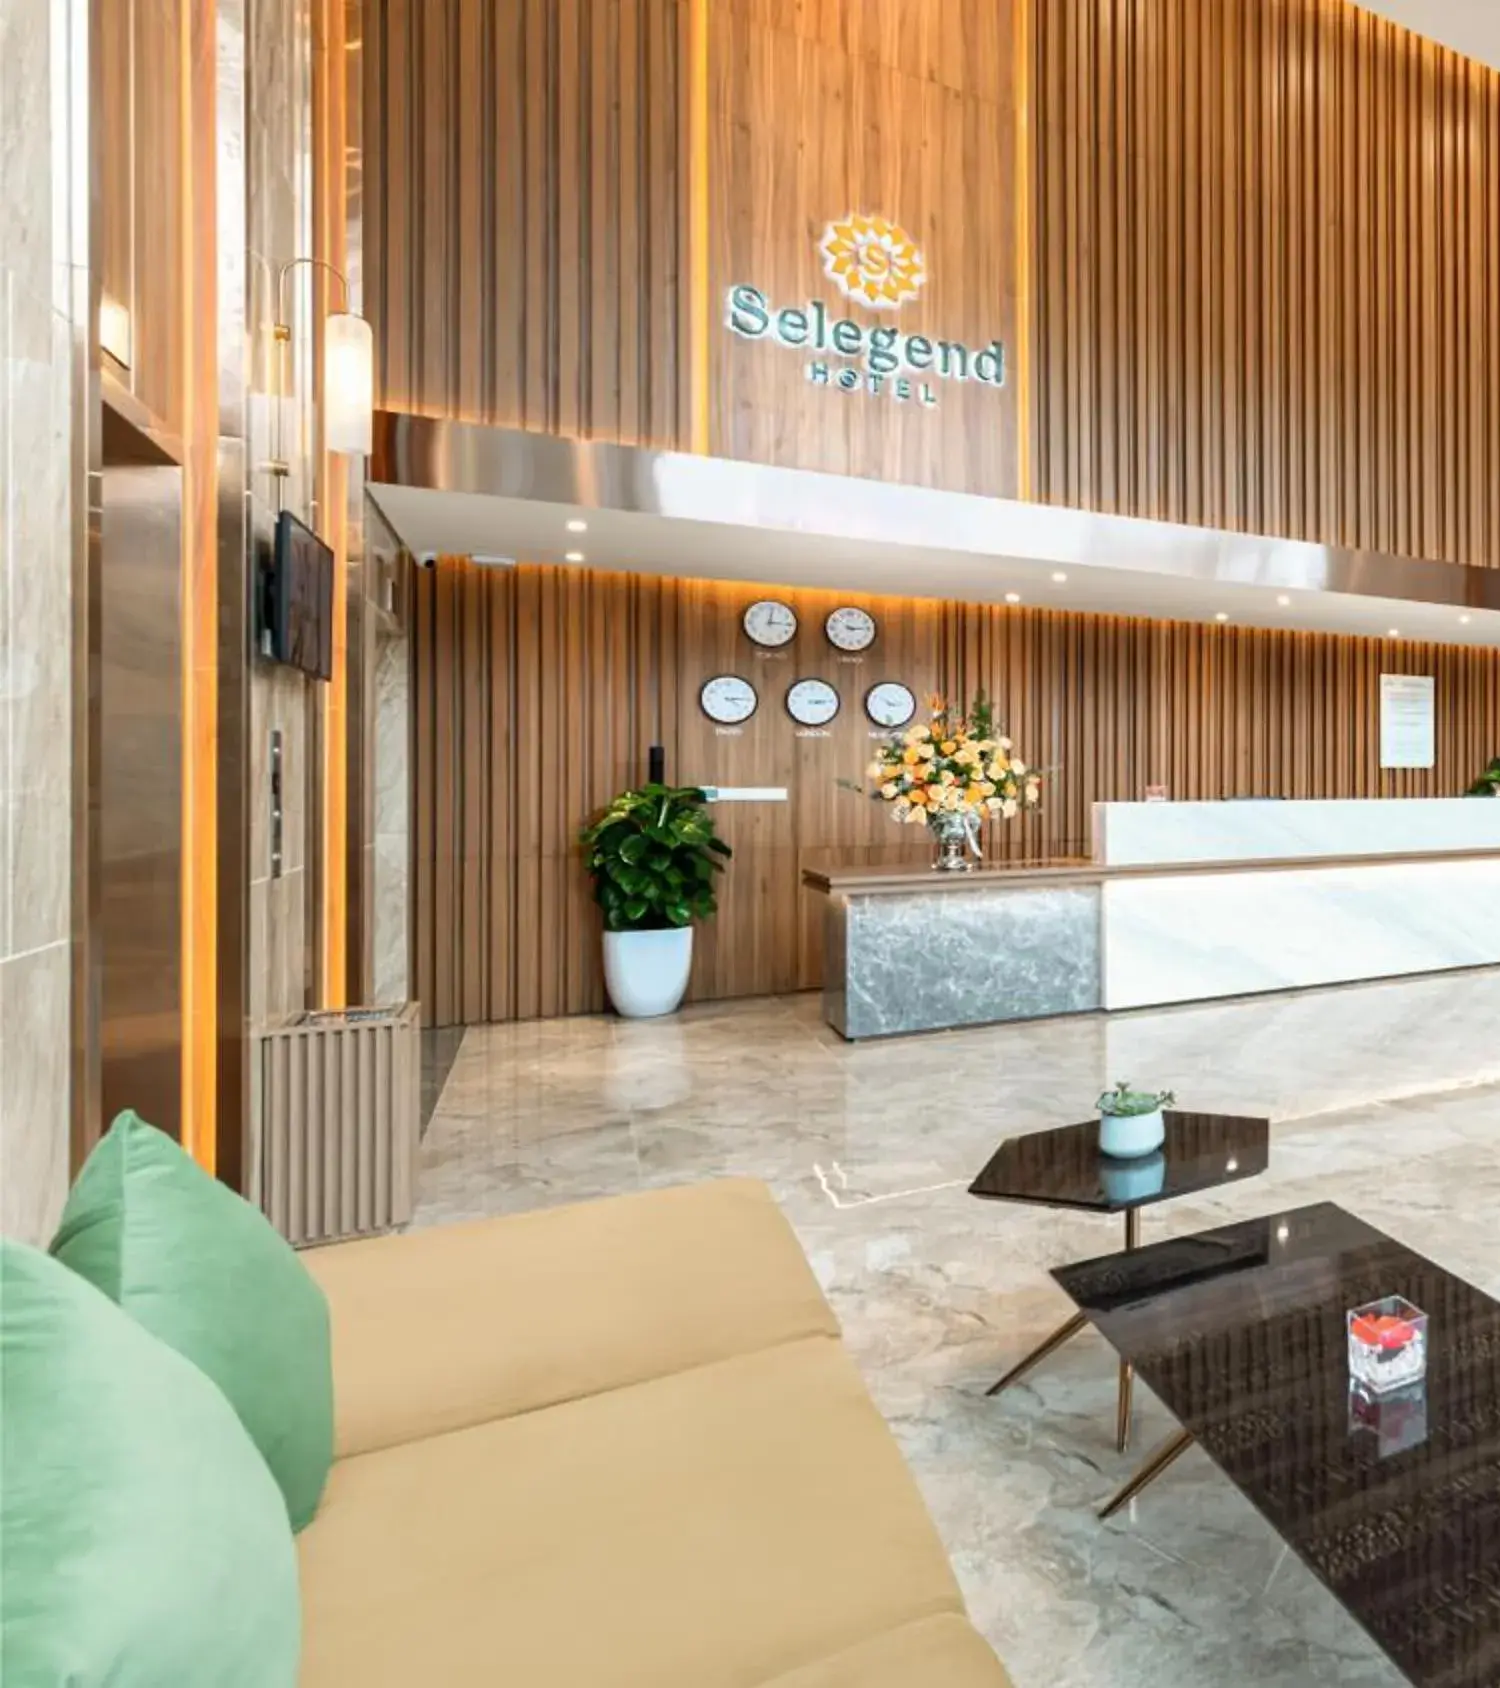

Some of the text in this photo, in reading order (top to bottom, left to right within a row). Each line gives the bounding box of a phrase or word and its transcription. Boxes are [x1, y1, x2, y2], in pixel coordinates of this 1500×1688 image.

[861, 244, 888, 277] S
[729, 285, 1004, 385] Selegend
[810, 362, 937, 404] HOTEL
